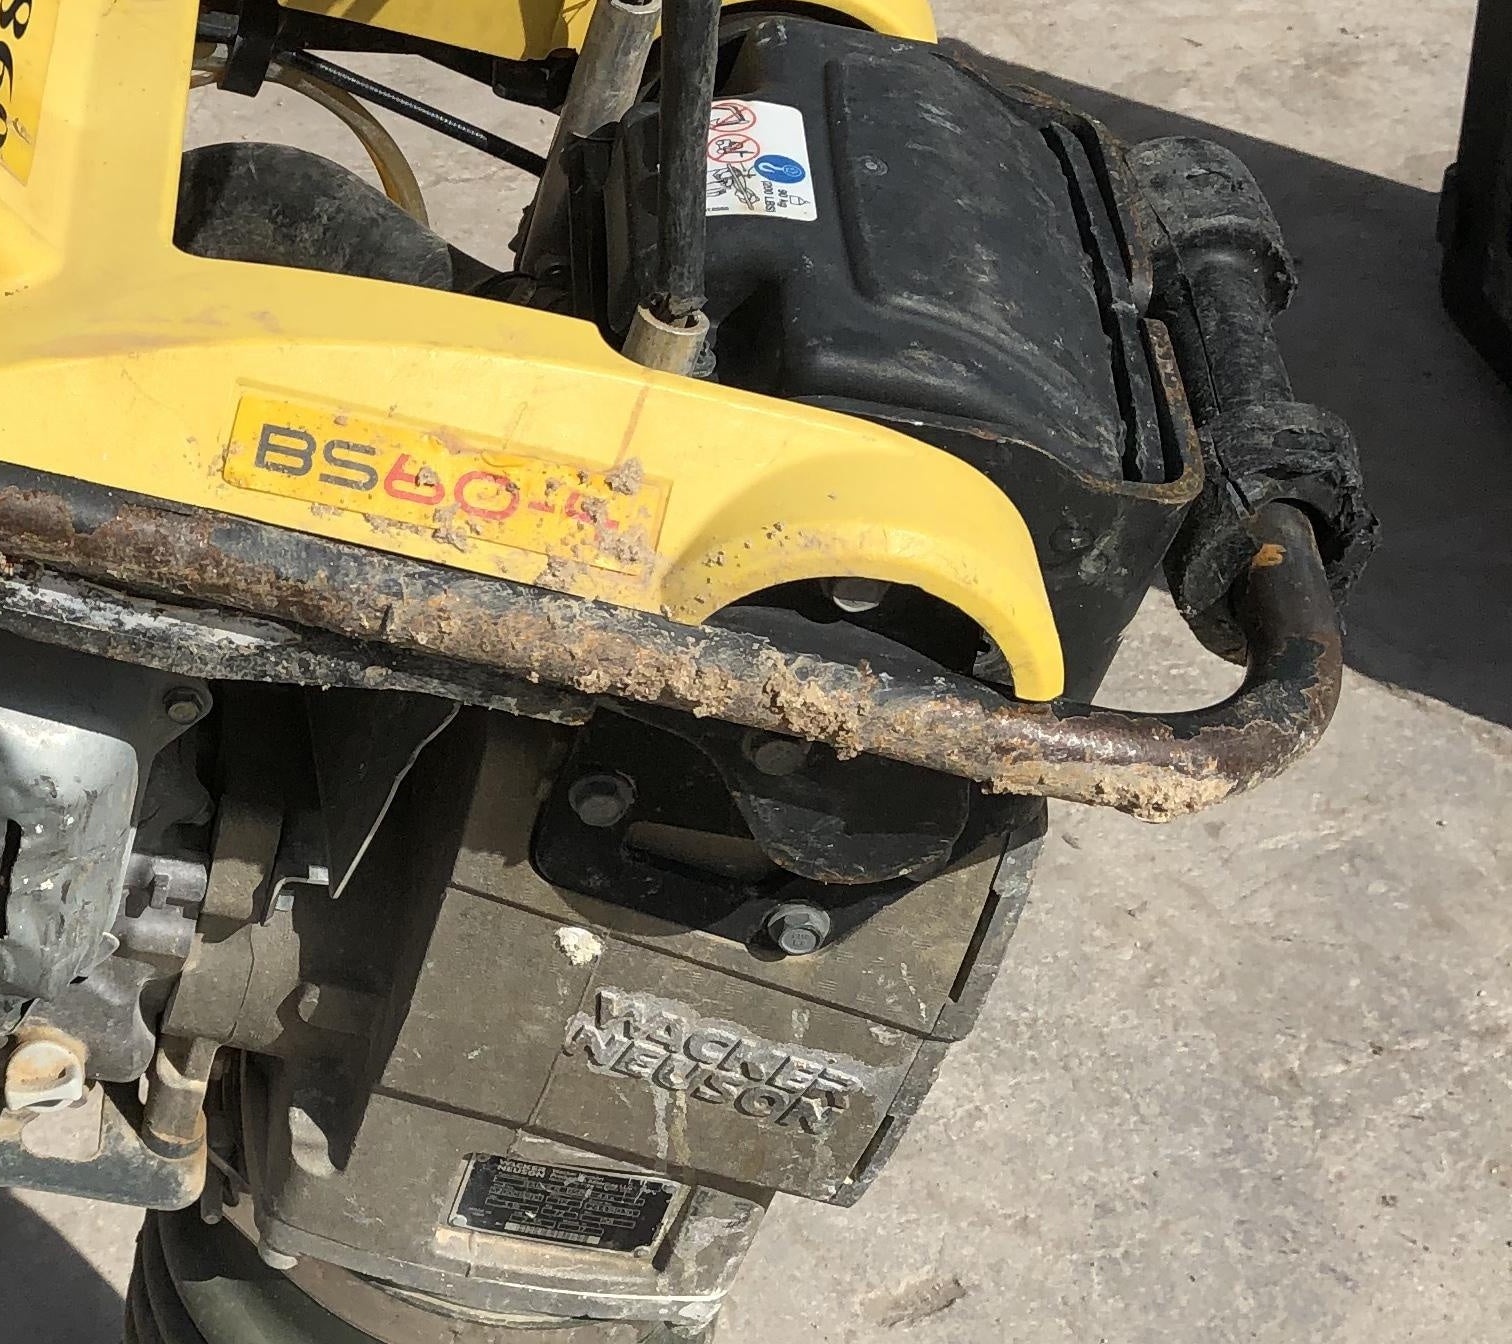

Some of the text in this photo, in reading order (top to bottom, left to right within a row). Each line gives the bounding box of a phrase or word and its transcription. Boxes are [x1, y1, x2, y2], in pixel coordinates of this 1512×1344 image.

[563, 1024, 833, 1135] NEUSON
[595, 991, 861, 1110] WACKER
[497, 1165, 546, 1178] NEUSON
